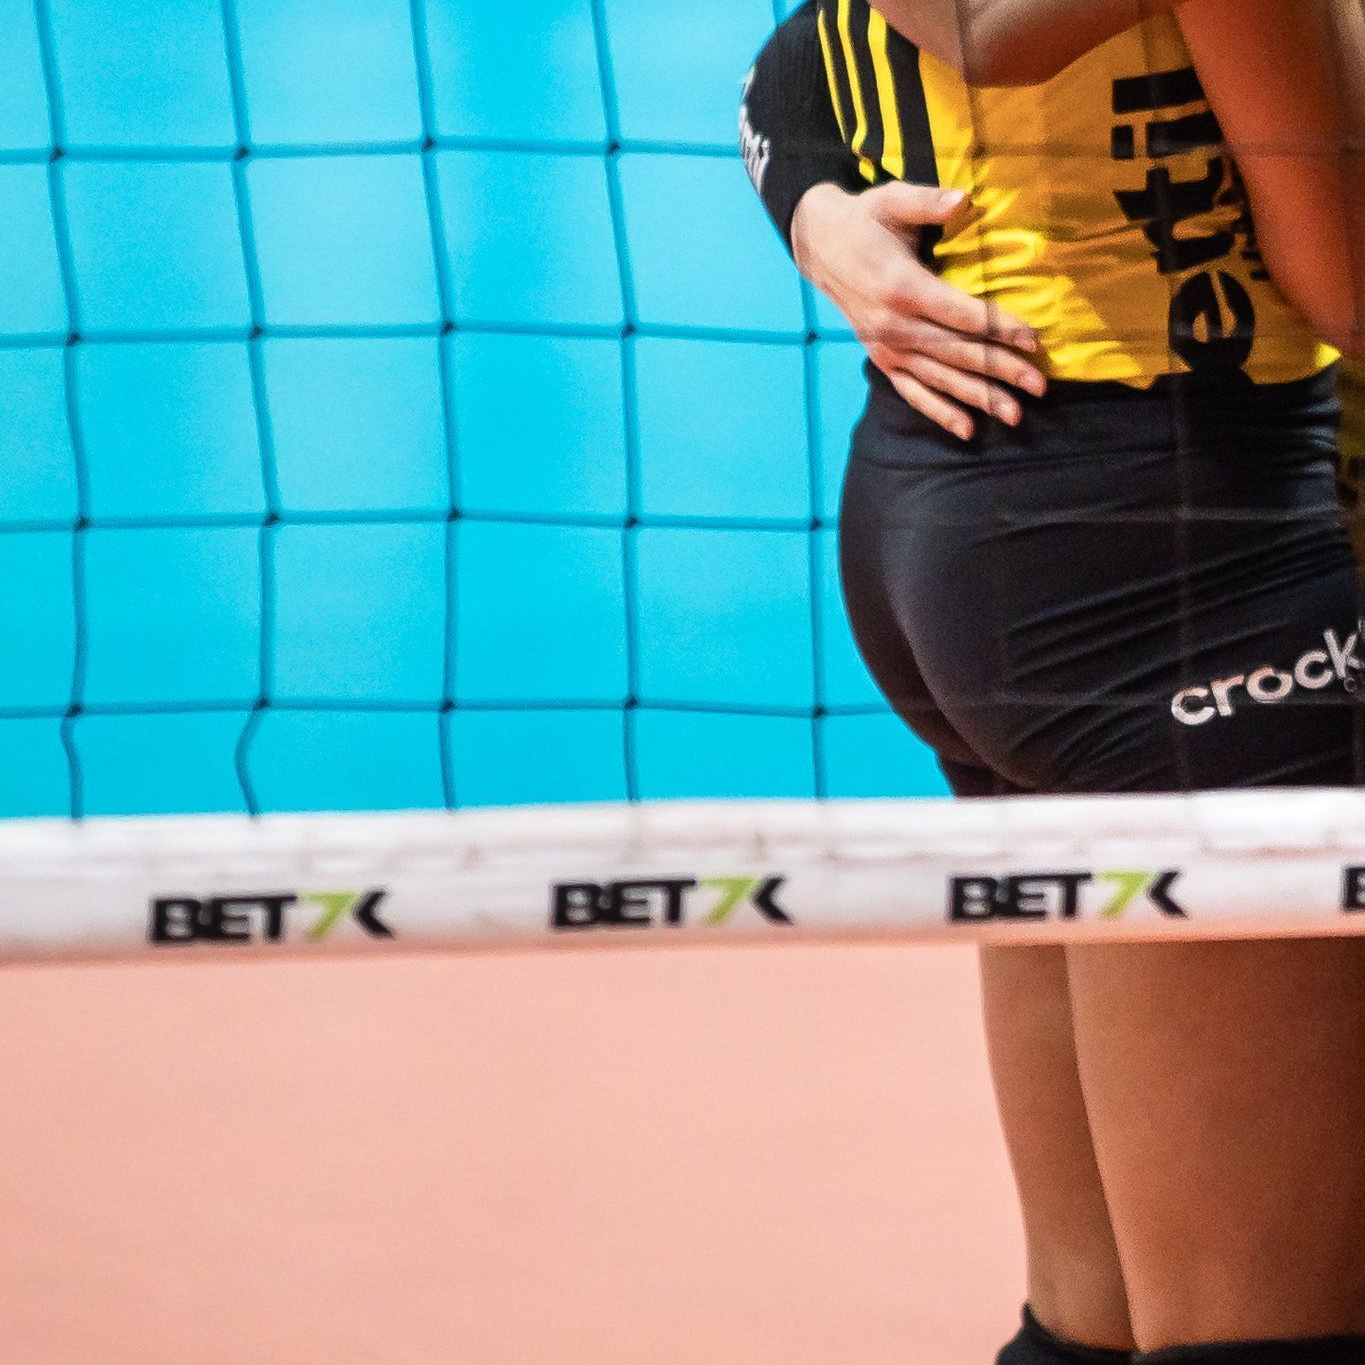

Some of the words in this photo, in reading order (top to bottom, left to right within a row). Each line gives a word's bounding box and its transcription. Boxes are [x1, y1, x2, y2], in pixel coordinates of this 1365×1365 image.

[147, 889, 394, 948] BET7K
[549, 875, 792, 932] BET7K
[947, 868, 1187, 925] BET7K
